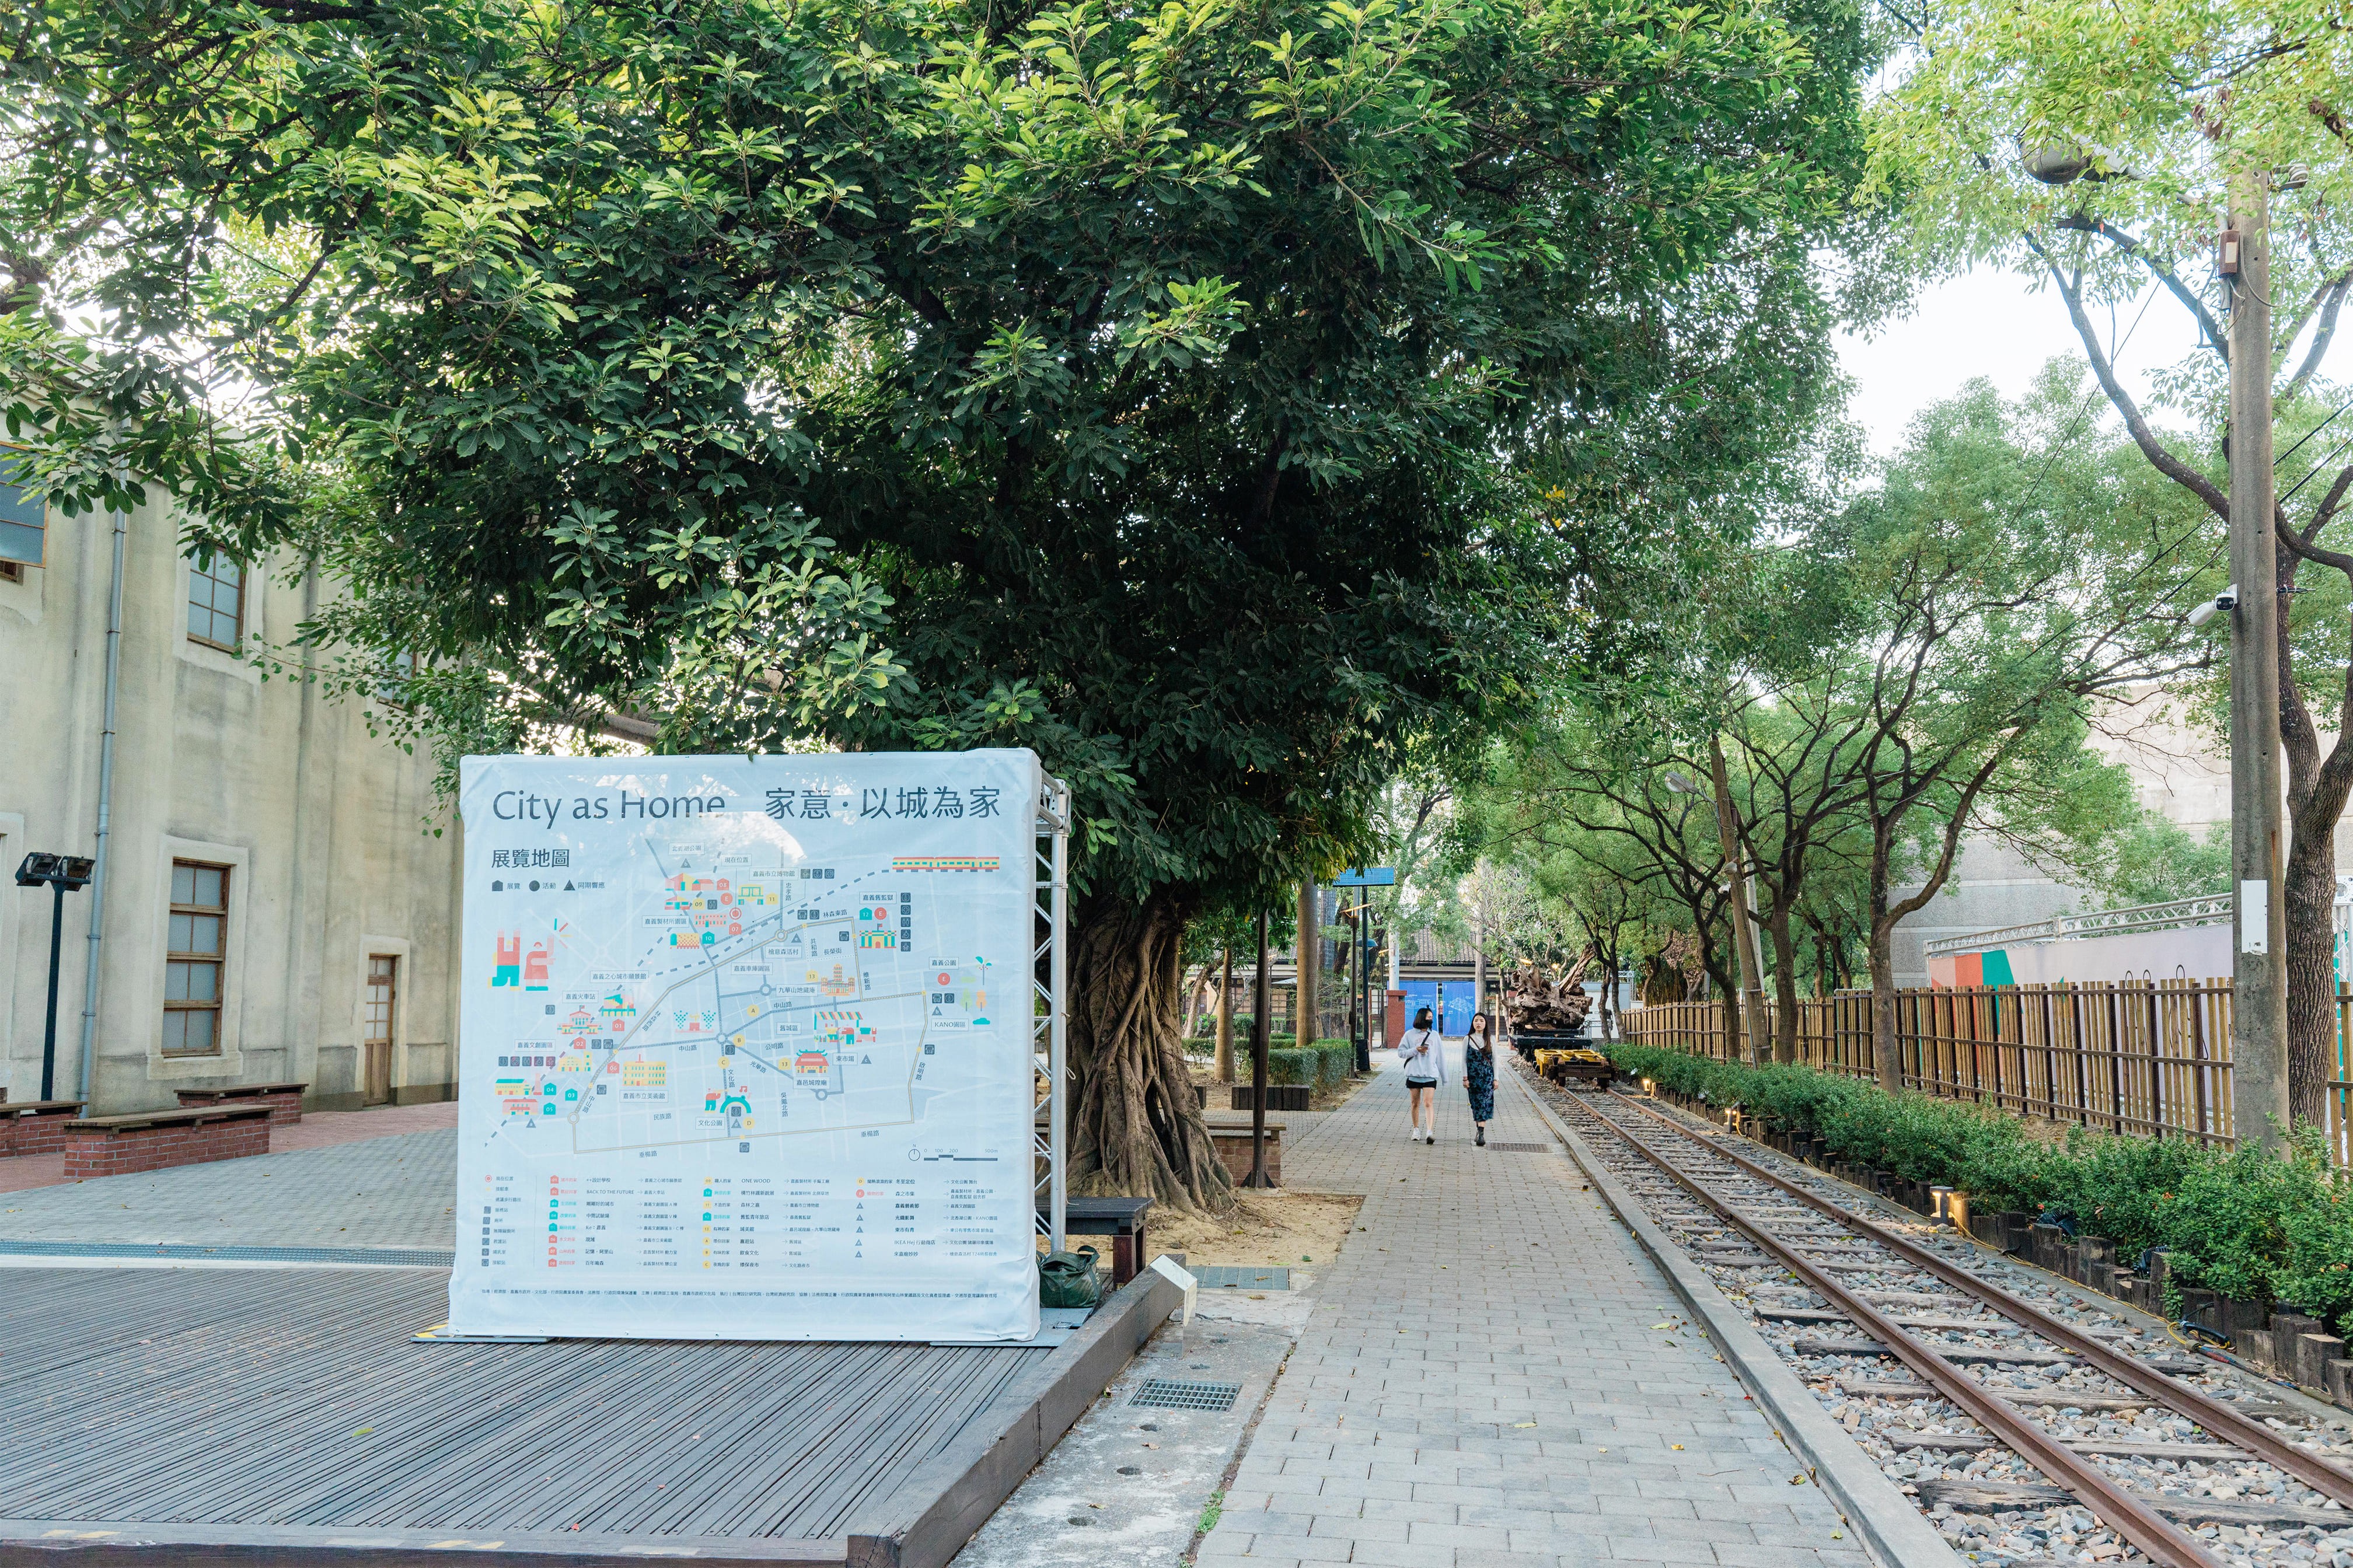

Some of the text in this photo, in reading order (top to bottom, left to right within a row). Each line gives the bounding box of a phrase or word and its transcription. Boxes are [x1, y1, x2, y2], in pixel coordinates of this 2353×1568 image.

[493, 790, 725, 829] City as Home
[491, 848, 570, 868] 展覽地圖
[507, 882, 521, 890] 展覽
[542, 882, 556, 890] 活動
[578, 881, 605, 889] 同期響應
[823, 909, 847, 918] 林森東路
[773, 1001, 792, 1009] 中山路
[749, 1060, 767, 1074] 光華路
[582, 1096, 595, 1113] 中山路
